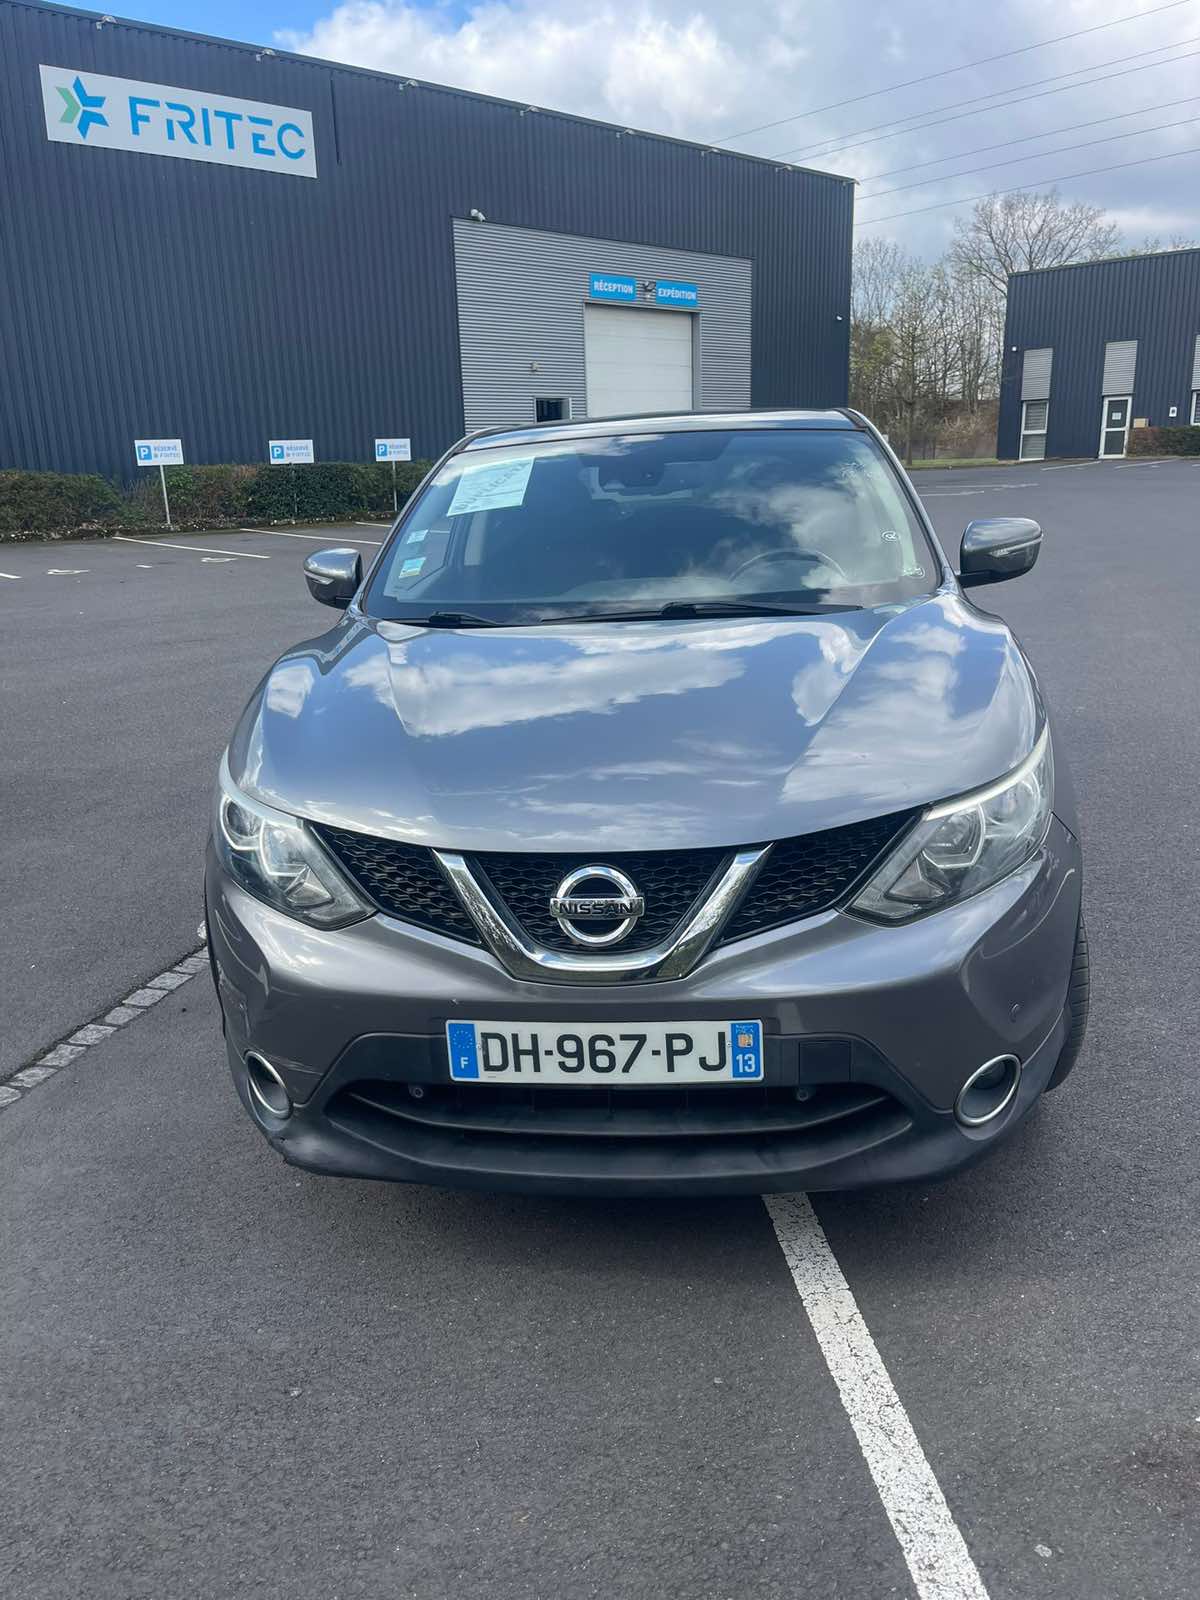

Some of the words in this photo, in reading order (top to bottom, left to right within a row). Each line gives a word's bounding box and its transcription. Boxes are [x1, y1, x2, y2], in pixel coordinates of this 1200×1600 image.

[128, 95, 306, 160] FRITEC
[593, 279, 633, 294] RÉCEPTION
[657, 286, 697, 301] EXPÉDITION
[558, 902, 633, 914] NISSAN
[480, 1031, 727, 1074] DH-967-PJ
[460, 1056, 469, 1069] F
[736, 1053, 755, 1073] 13
